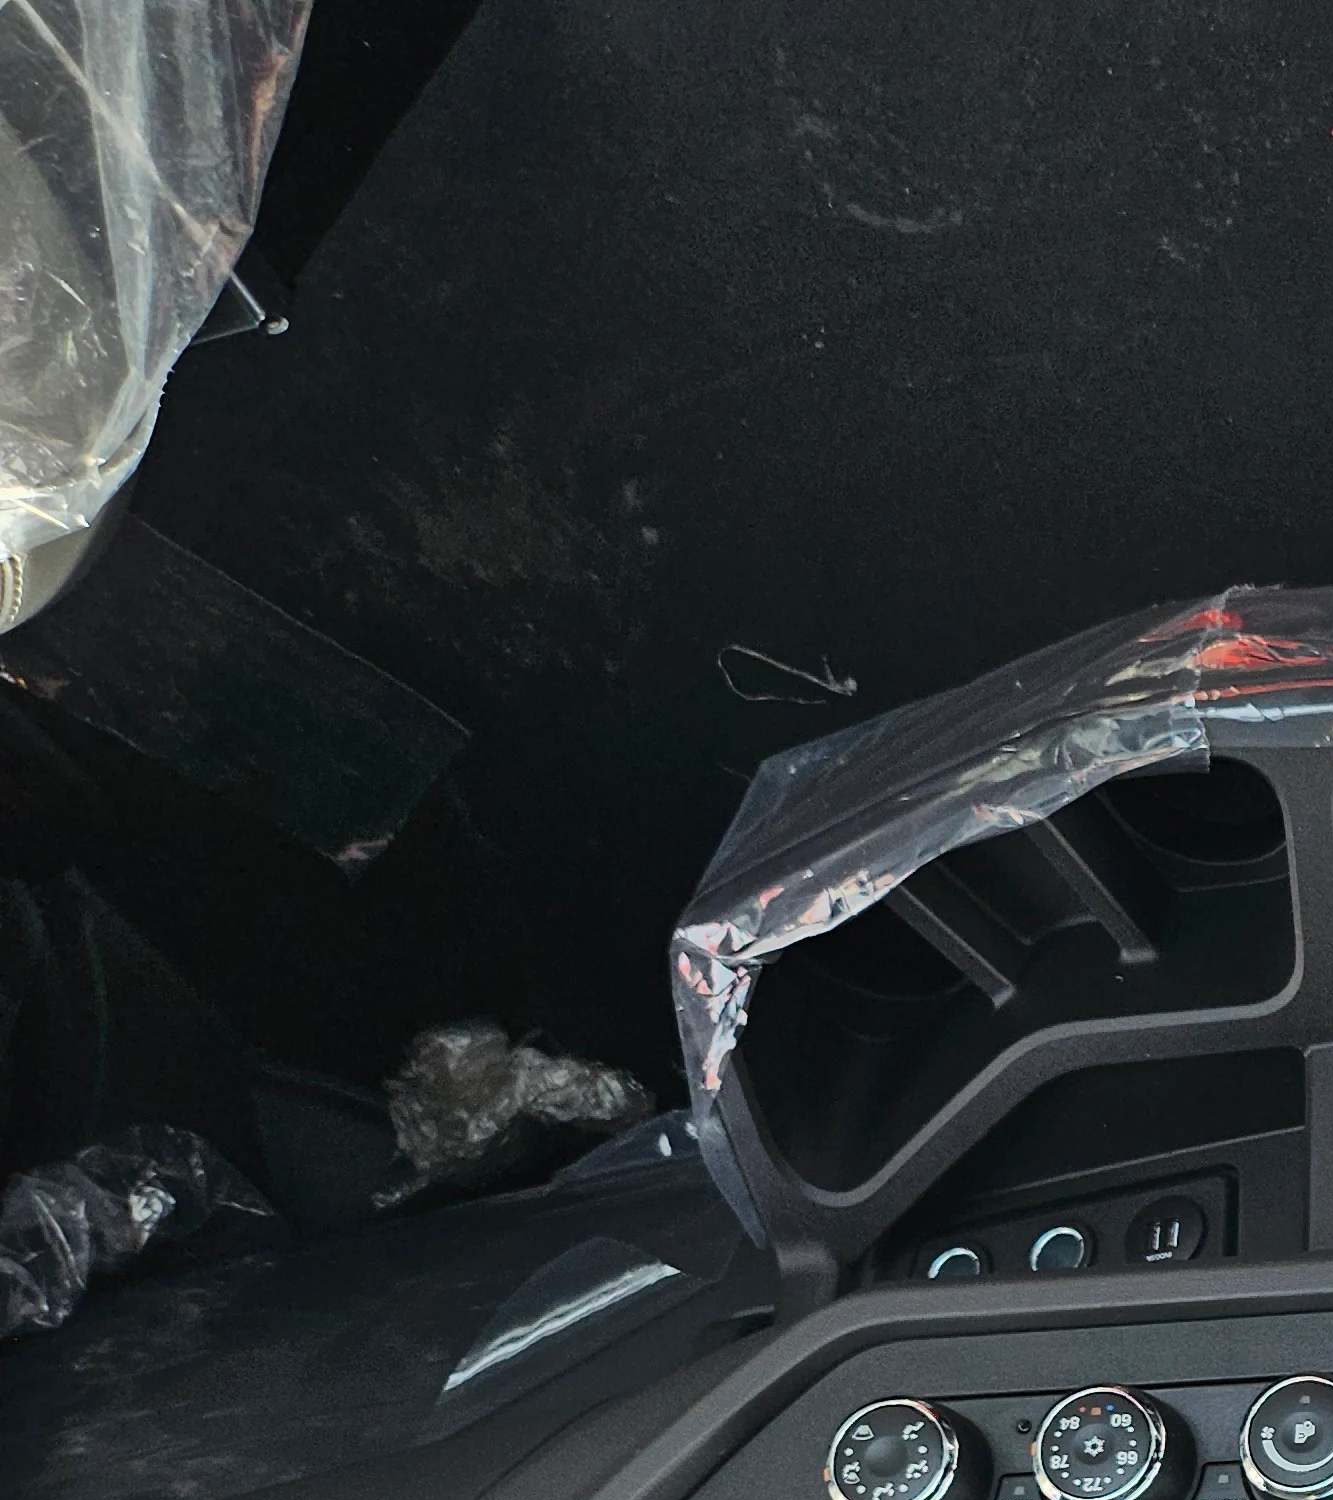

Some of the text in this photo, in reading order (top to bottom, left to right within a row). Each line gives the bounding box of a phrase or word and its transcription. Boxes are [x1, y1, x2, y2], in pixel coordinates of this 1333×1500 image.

[1058, 1414, 1080, 1432] 84
[1110, 1413, 1132, 1429] 60
[1050, 1454, 1070, 1470] 78
[1116, 1450, 1138, 1466] 66
[1082, 1476, 1102, 1491] 72
